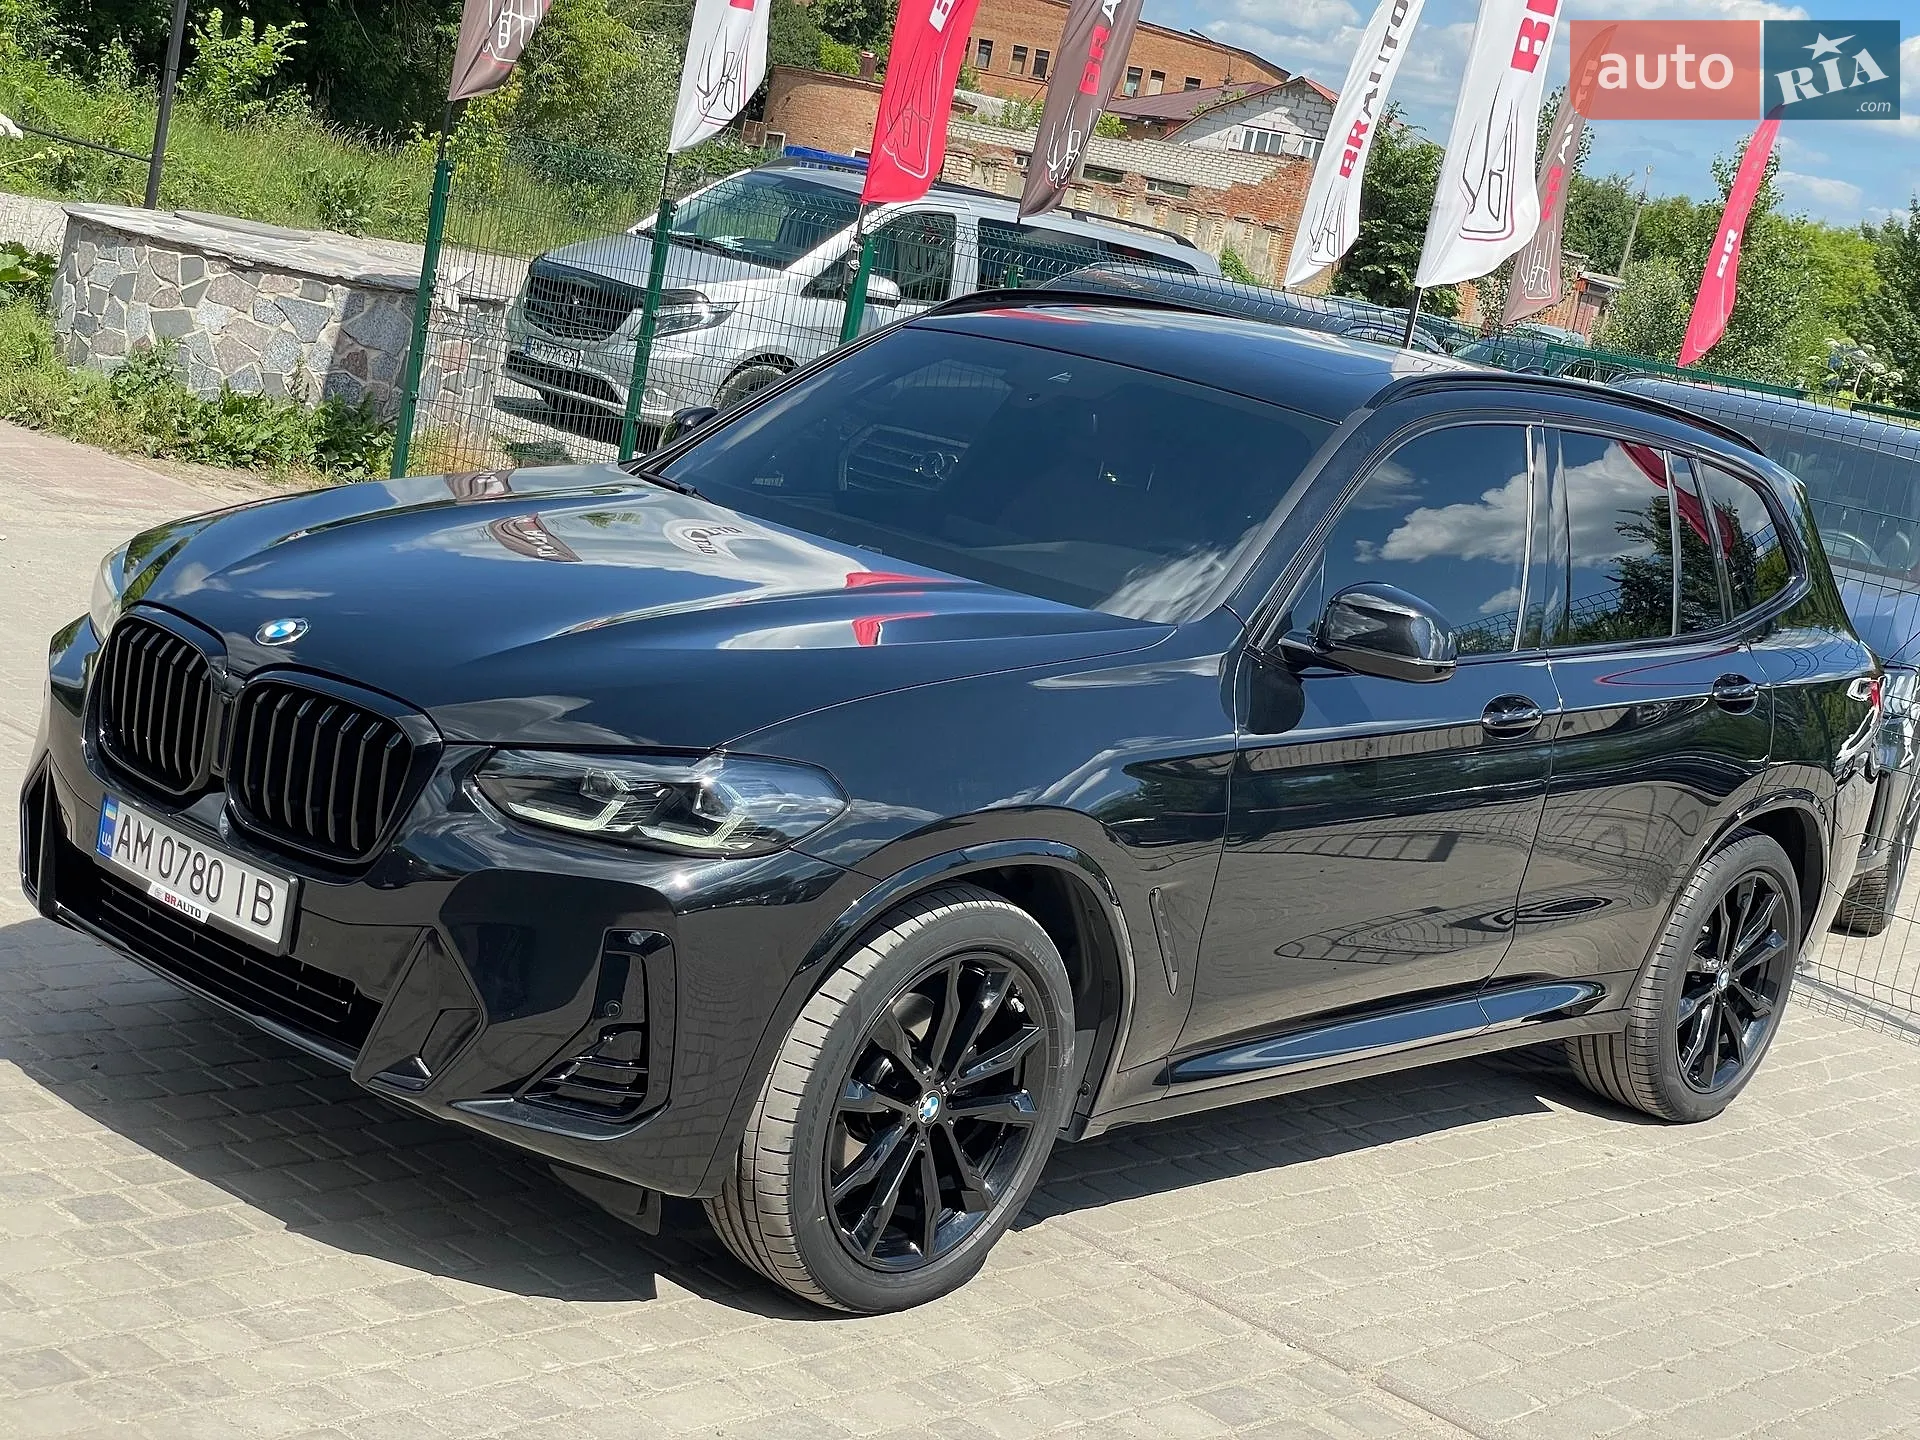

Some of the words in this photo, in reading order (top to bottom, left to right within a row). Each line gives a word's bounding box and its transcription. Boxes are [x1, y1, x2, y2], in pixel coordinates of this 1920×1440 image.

[101, 831, 112, 845] UA
[115, 814, 155, 870] AM
[159, 835, 225, 903] 0780
[235, 872, 274, 926] IB
[164, 892, 201, 919] BRAUTO
